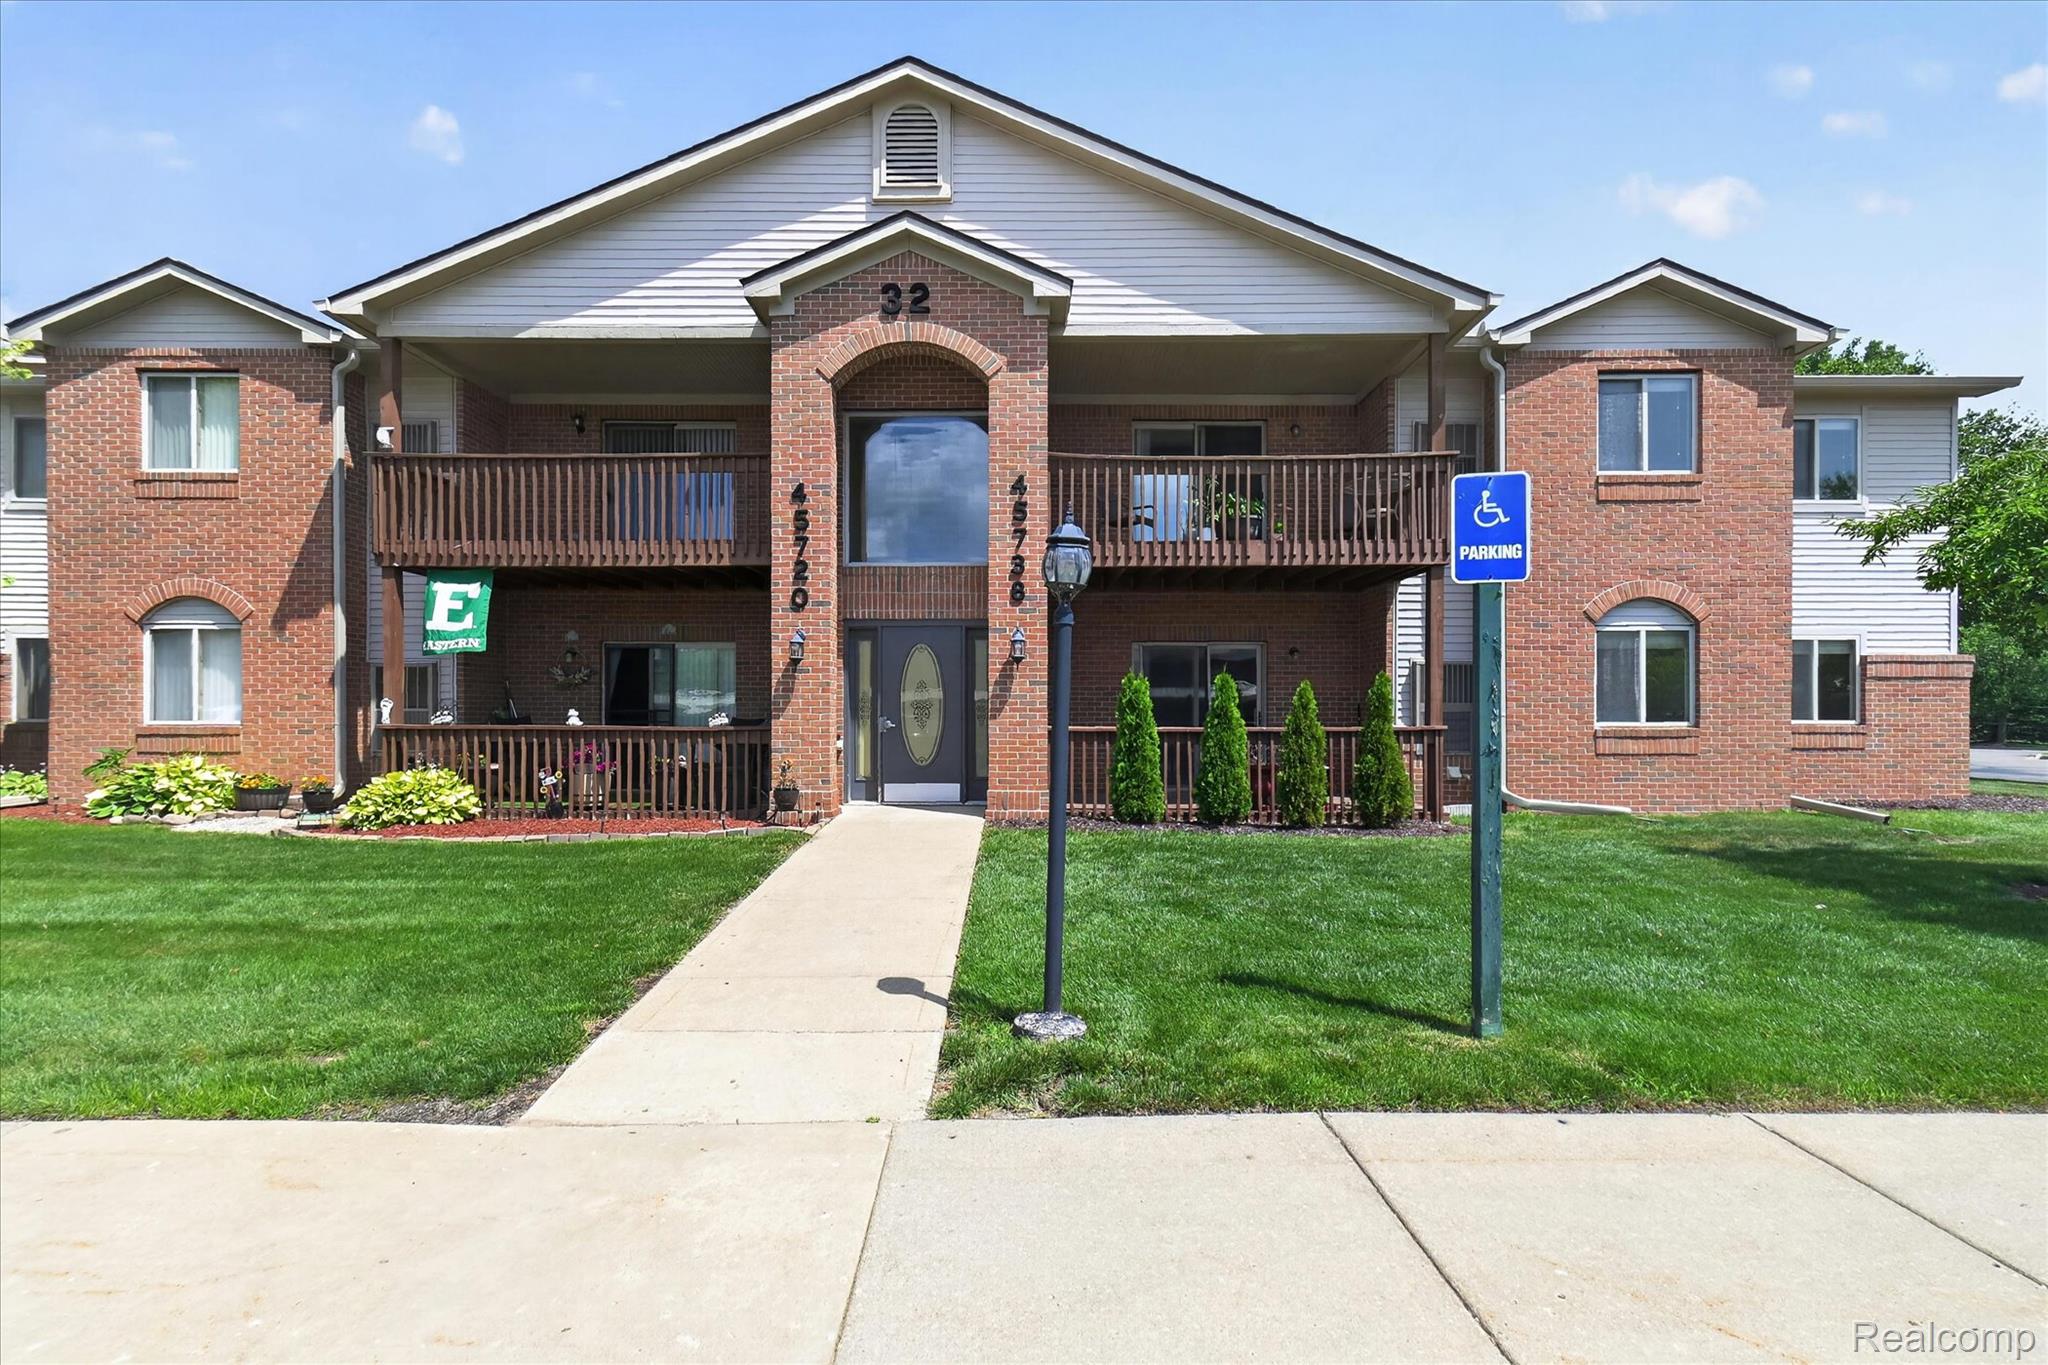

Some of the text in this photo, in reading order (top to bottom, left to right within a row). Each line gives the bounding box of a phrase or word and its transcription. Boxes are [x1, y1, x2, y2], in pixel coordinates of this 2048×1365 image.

[881, 282, 931, 315] 32
[1009, 474, 1028, 602] 45738
[1459, 543, 1522, 561] PARKING
[425, 581, 482, 632] E
